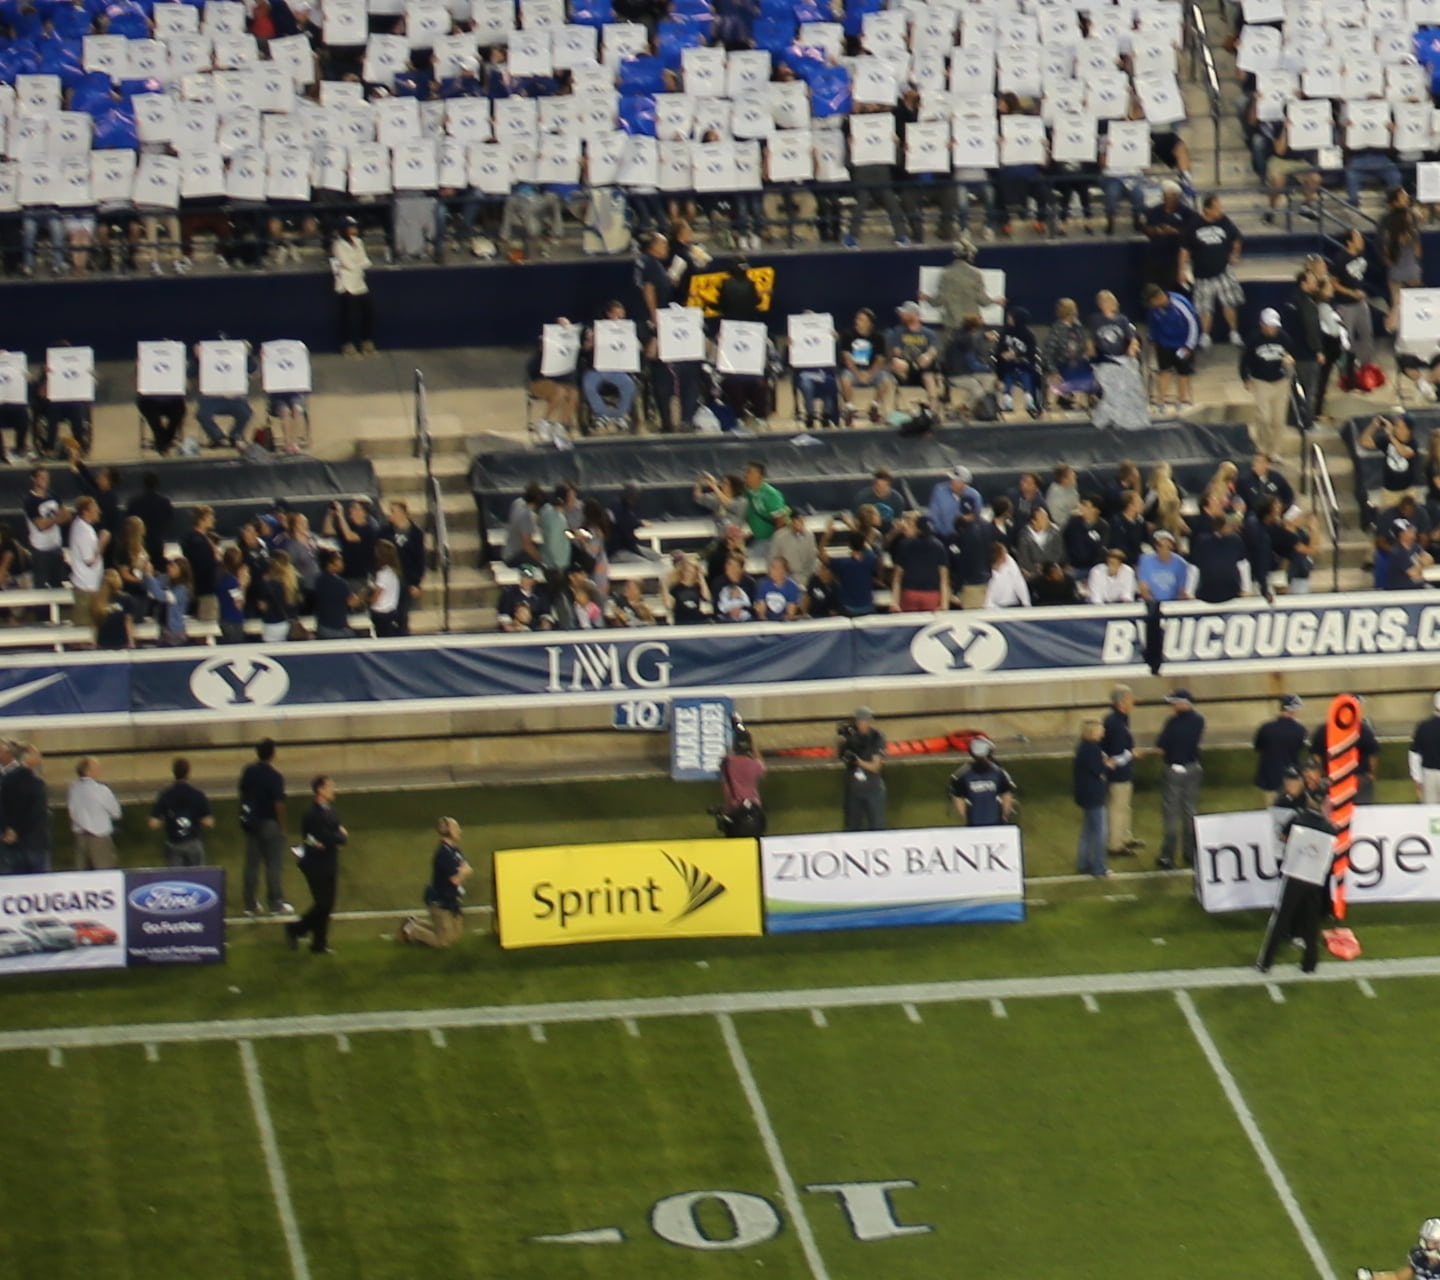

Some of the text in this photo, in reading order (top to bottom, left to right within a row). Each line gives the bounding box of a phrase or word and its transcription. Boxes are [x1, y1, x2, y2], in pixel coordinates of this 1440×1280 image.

[546, 643, 673, 692] IMG
[620, 701, 661, 729] 10
[675, 706, 702, 773] MAKE
[770, 840, 1012, 882] ZIONS BANK
[2, 891, 116, 915] COUGARS
[531, 877, 662, 928] Sprint
[648, 1177, 936, 1252] 10
